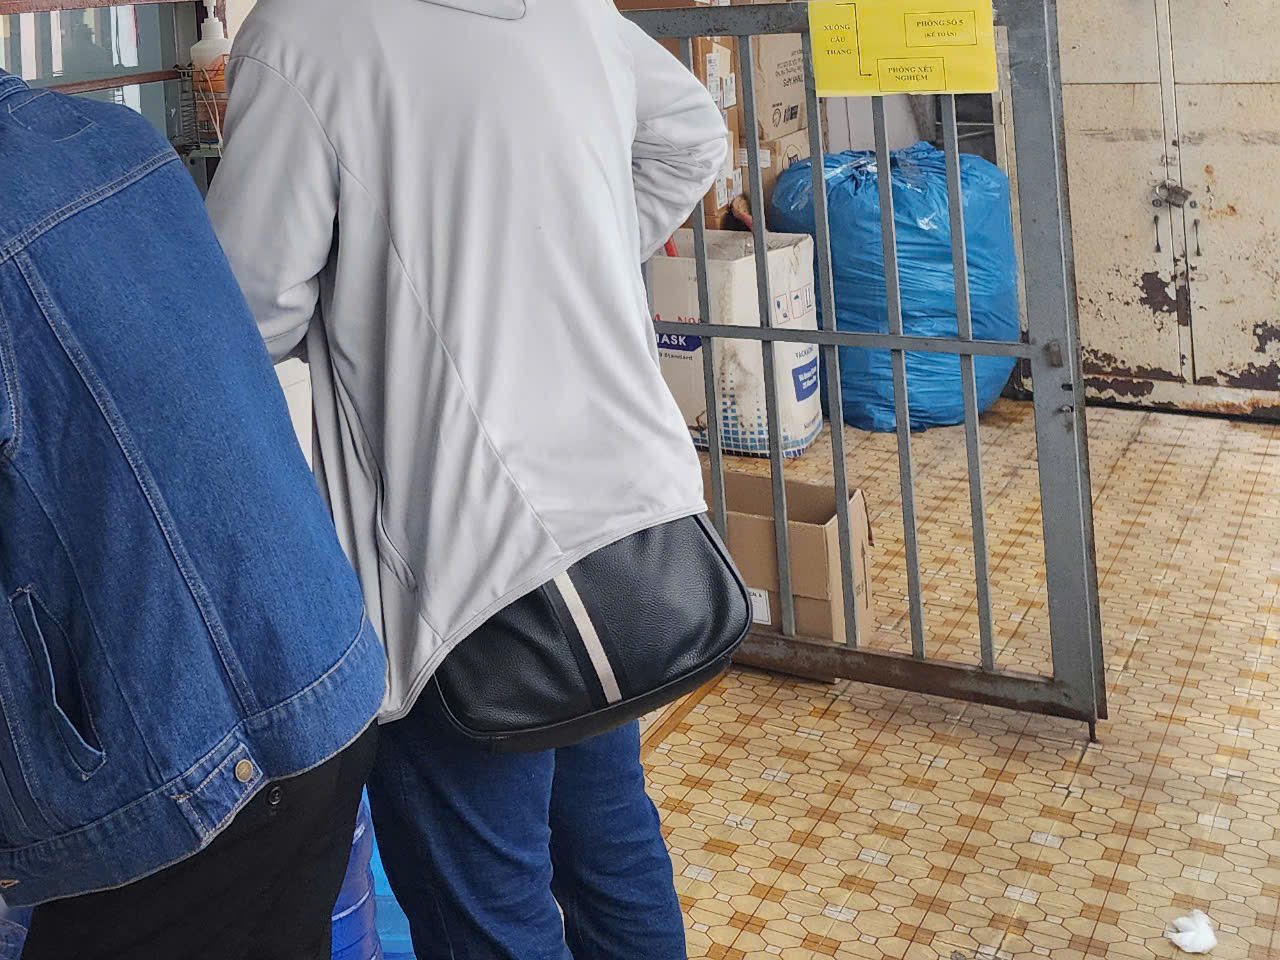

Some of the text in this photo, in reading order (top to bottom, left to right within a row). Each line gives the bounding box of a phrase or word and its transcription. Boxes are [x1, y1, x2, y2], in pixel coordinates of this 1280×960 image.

[916, 18, 945, 27] PHÒNG
[888, 65, 916, 73] PHÒNG
[664, 352, 693, 361] Standard
